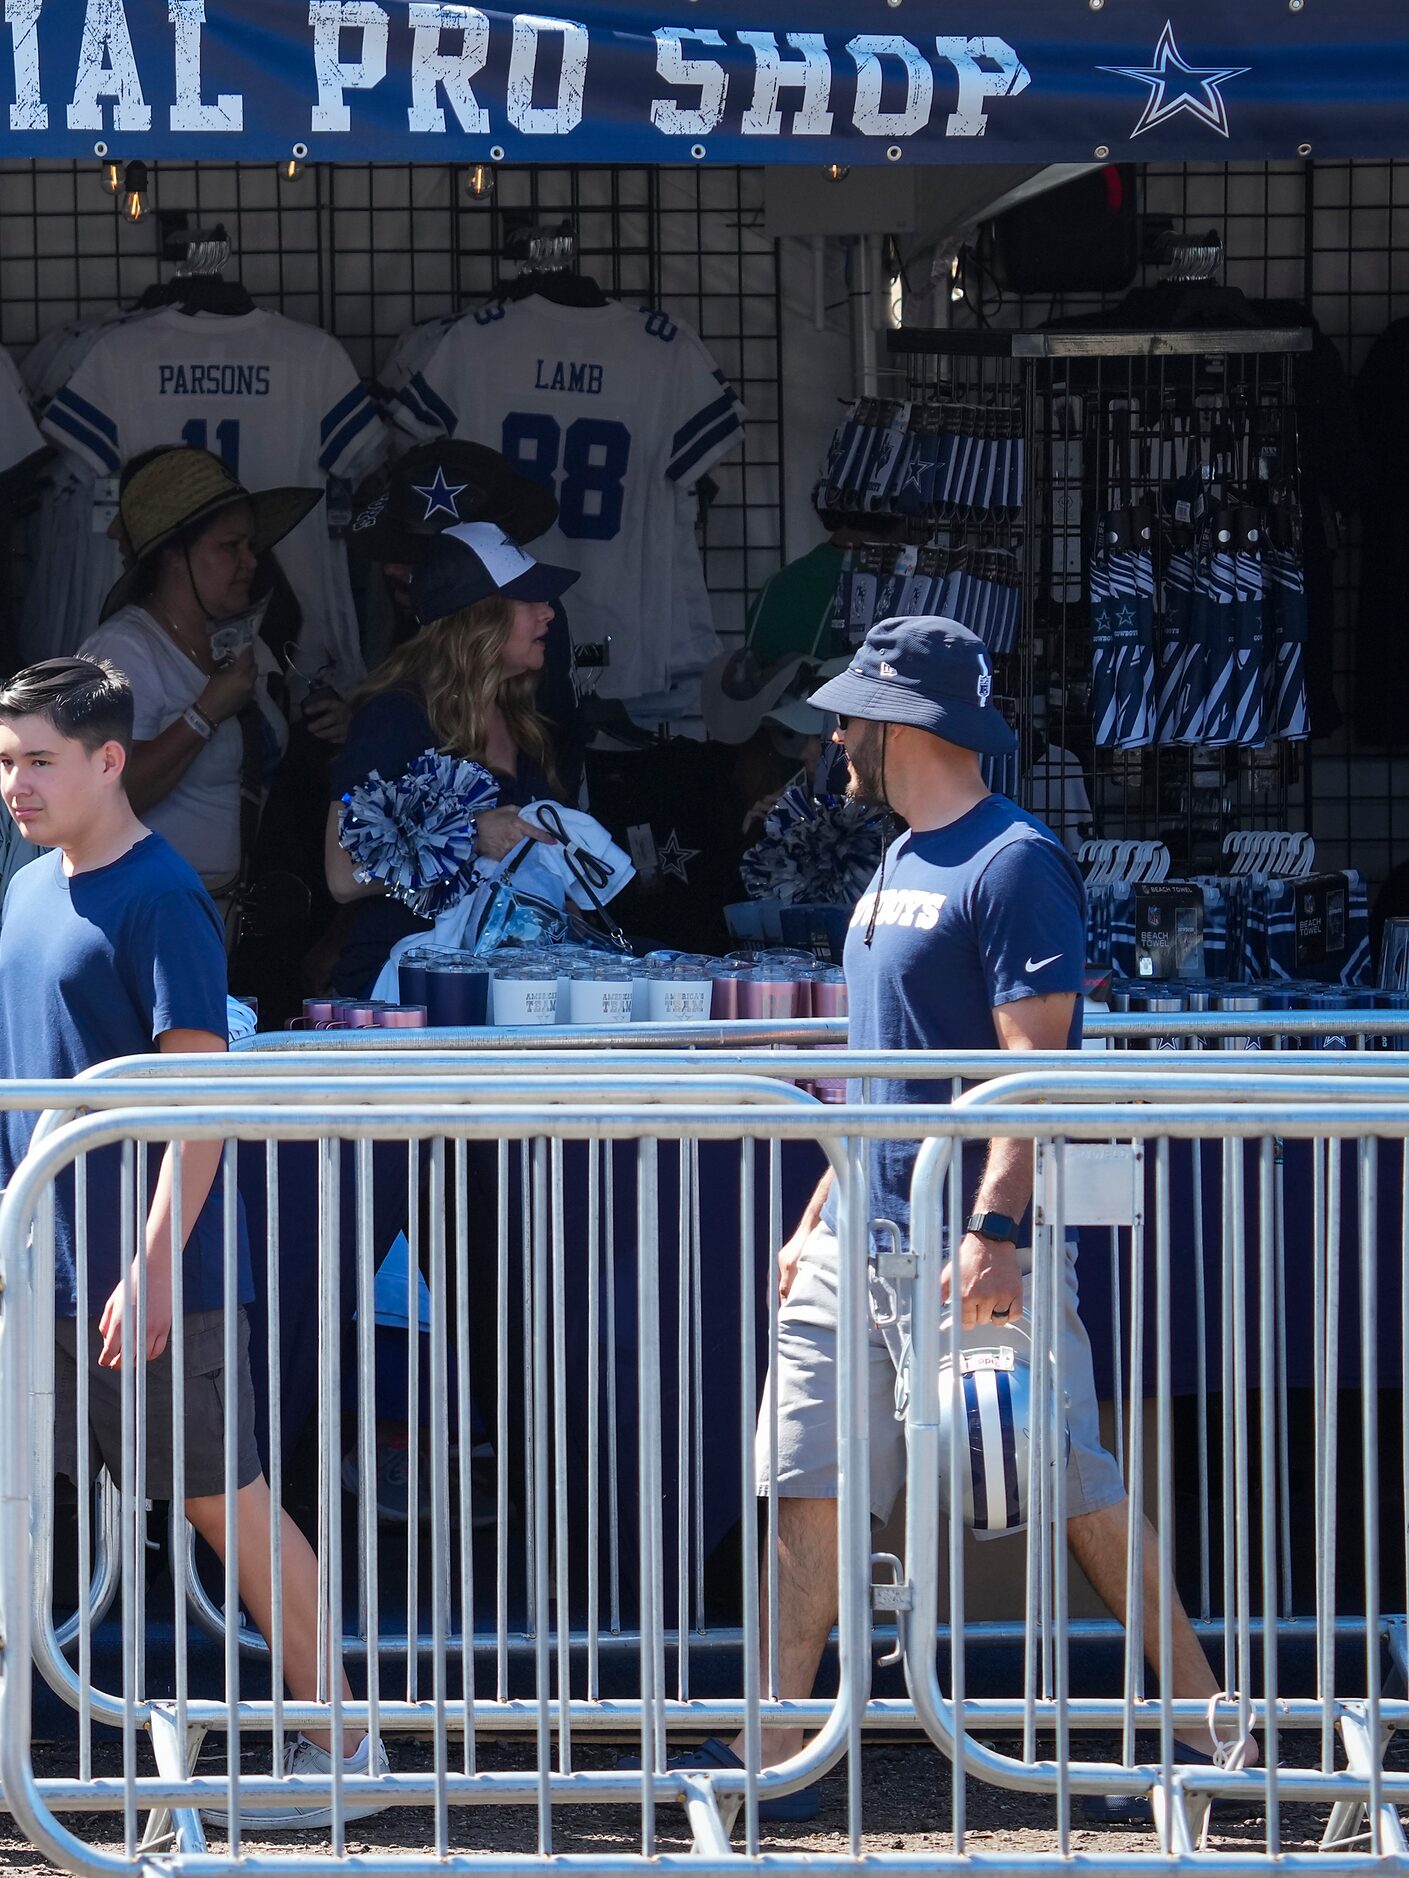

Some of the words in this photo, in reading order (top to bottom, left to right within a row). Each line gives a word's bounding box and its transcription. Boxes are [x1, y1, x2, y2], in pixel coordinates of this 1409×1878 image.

[308, 0, 589, 135] PRO
[650, 26, 1032, 137] SHOP
[158, 365, 271, 396] PARSONS
[535, 358, 604, 394] LAMB
[1141, 931, 1169, 940] BEACH
[665, 1000, 704, 1013] TEAM
